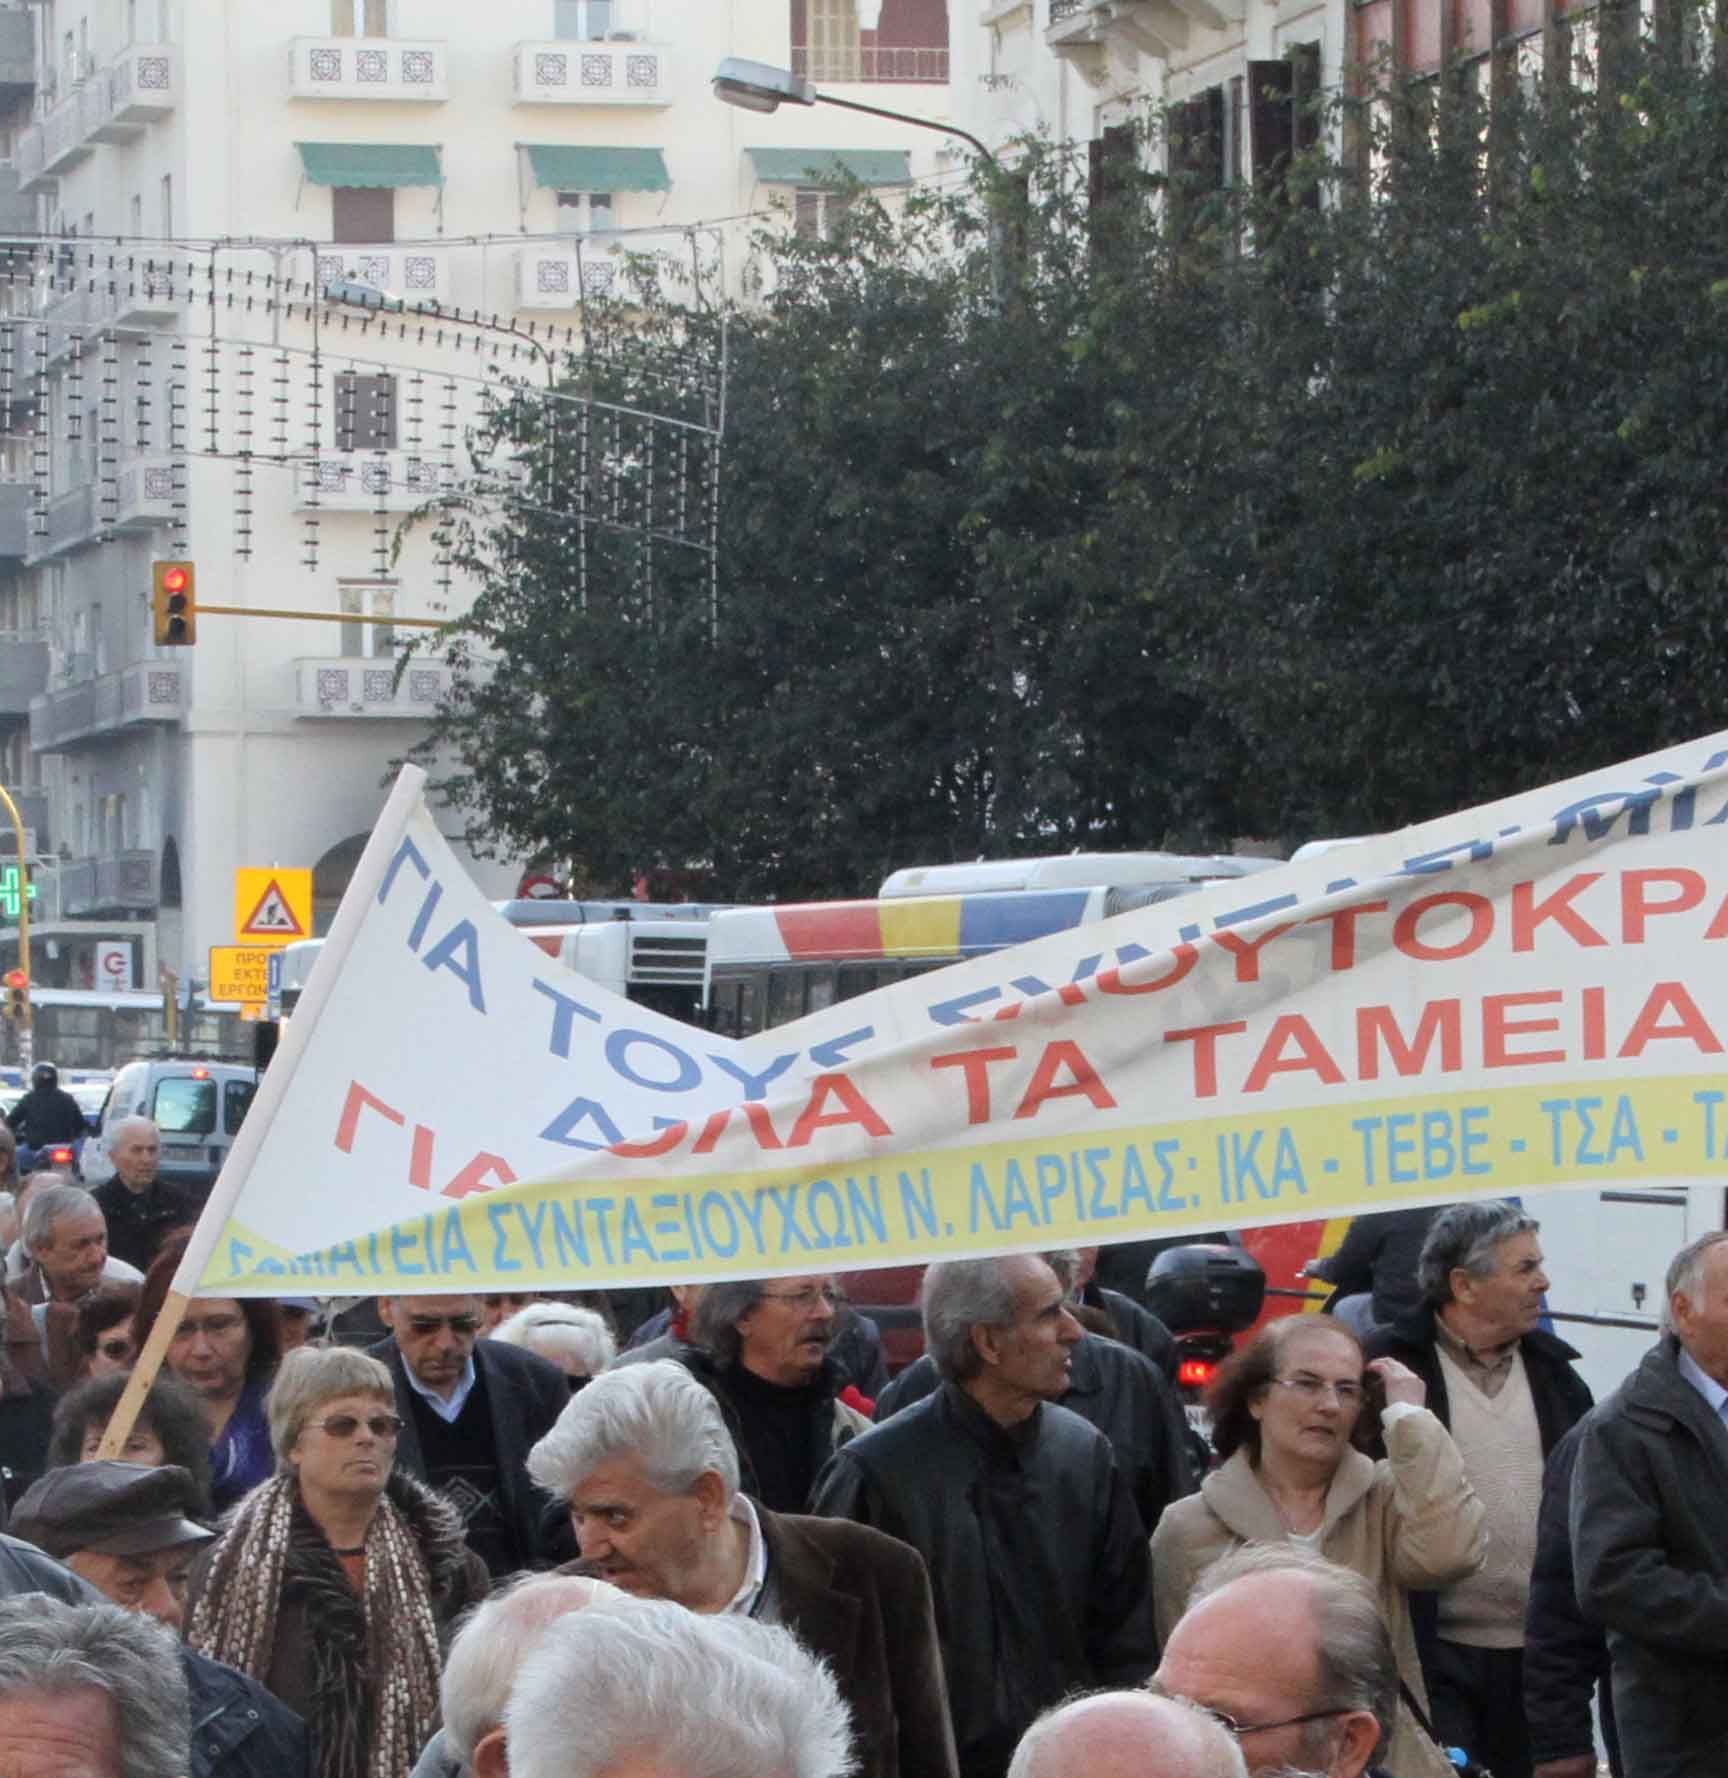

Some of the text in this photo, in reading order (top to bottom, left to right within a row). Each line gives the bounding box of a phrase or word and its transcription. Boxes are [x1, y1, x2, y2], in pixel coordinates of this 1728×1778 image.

[235, 952, 266, 965] ΠΡΟ
[377, 836, 486, 1015] ΓΙΑ
[532, 977, 876, 1100] ΤΟΥΣ
[930, 1039, 1118, 1124] ΤΑ
[1163, 980, 1724, 1099] ΤΑΜΕΙΑ
[488, 1178, 887, 1271] ΣΥΝΤΑΞΙΟΥΧΩΝ
[901, 1168, 954, 1240] Ν.
[972, 1139, 1200, 1232] ΛΑΡΙΣΑΣ:
[1218, 1128, 1307, 1204] ΙΚΑ
[1352, 1107, 1493, 1186] ΤΕΒΕ
[1542, 1095, 1644, 1167] ΤΣΑ
